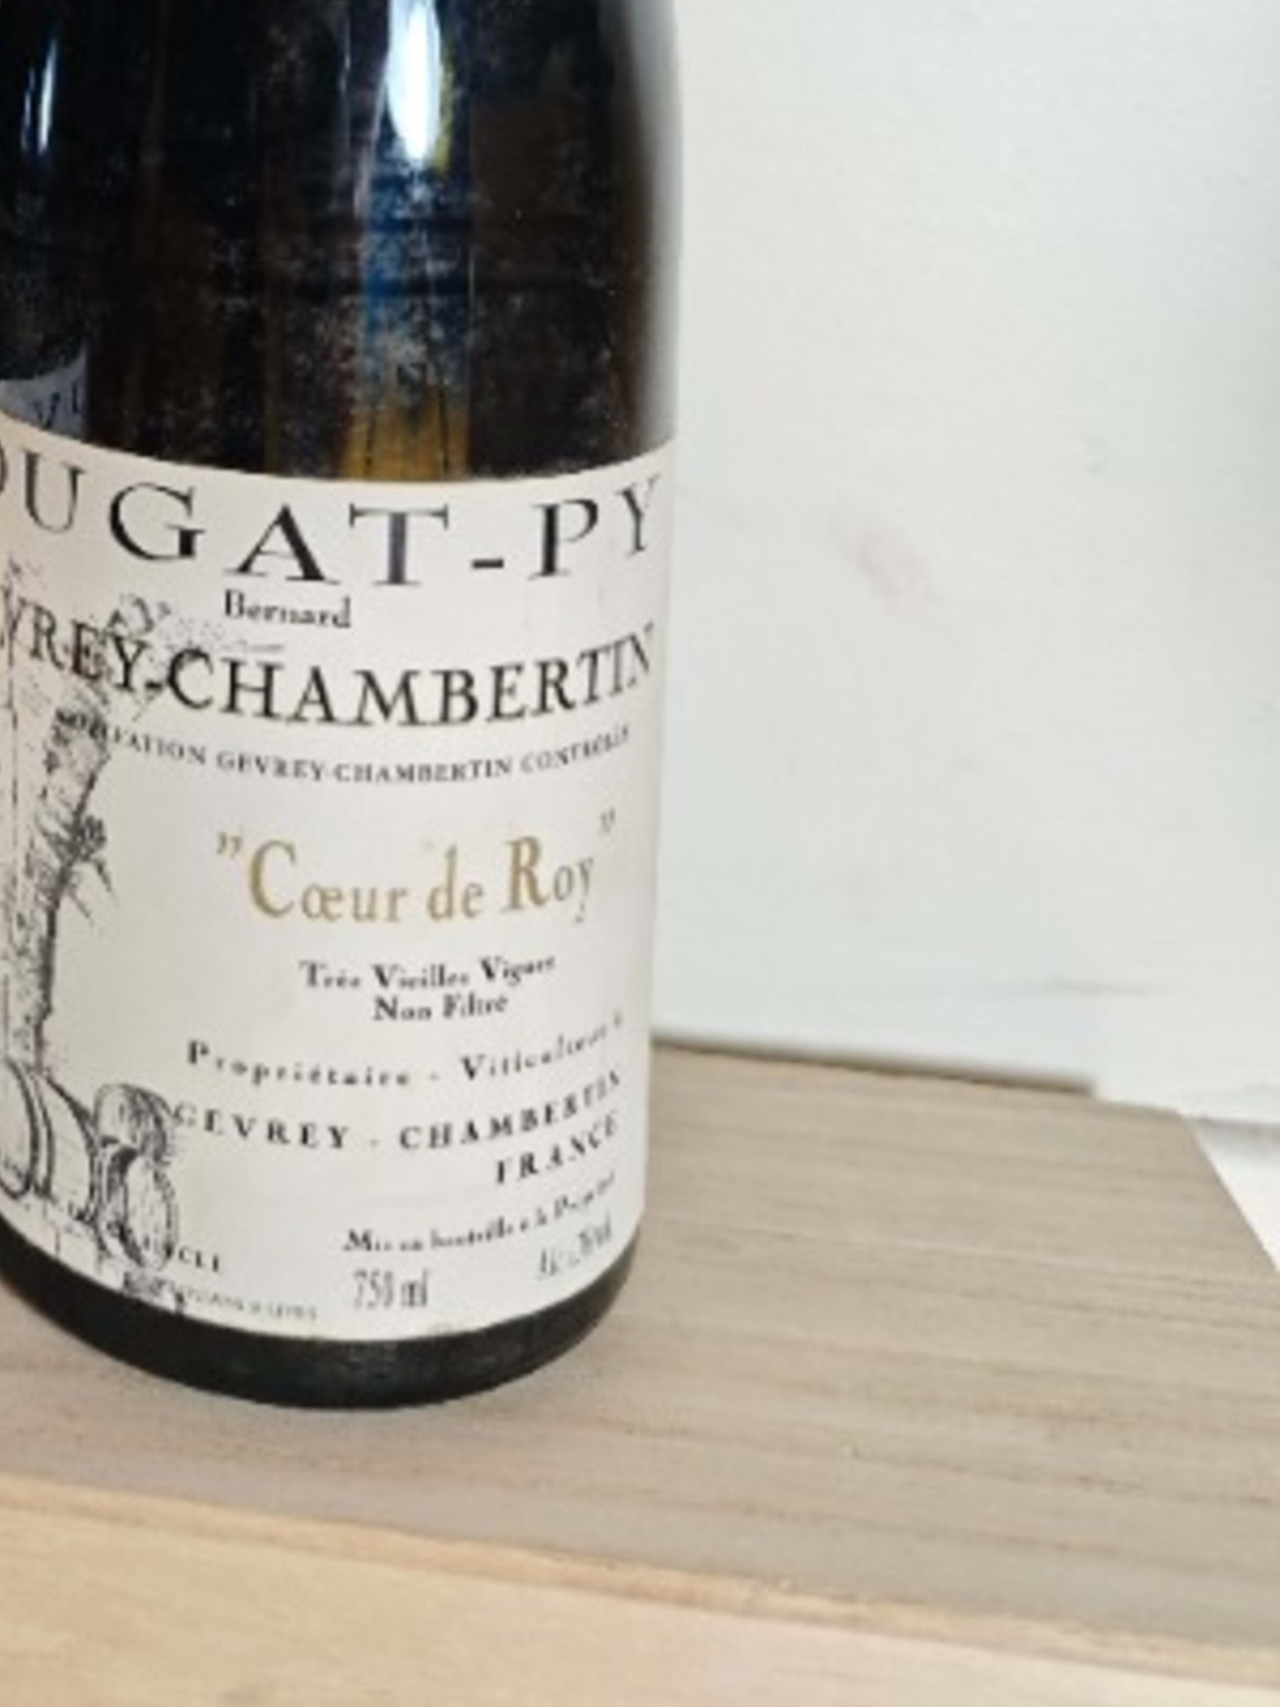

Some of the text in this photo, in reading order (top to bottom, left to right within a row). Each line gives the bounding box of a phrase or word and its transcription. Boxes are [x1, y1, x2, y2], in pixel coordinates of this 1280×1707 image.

[224, 589, 352, 629] Bernard
[429, 835, 484, 923] de
[371, 962, 470, 990] Vieilles
[478, 955, 556, 986] Vignes
[372, 994, 433, 1022] Non
[187, 1038, 411, 1088] Propriétaire
[173, 1102, 349, 1151] GEVREY
[398, 1068, 621, 1151] CHAMBERTIN
[495, 1109, 618, 1185] FRANCE
[352, 1268, 394, 1309] 750
